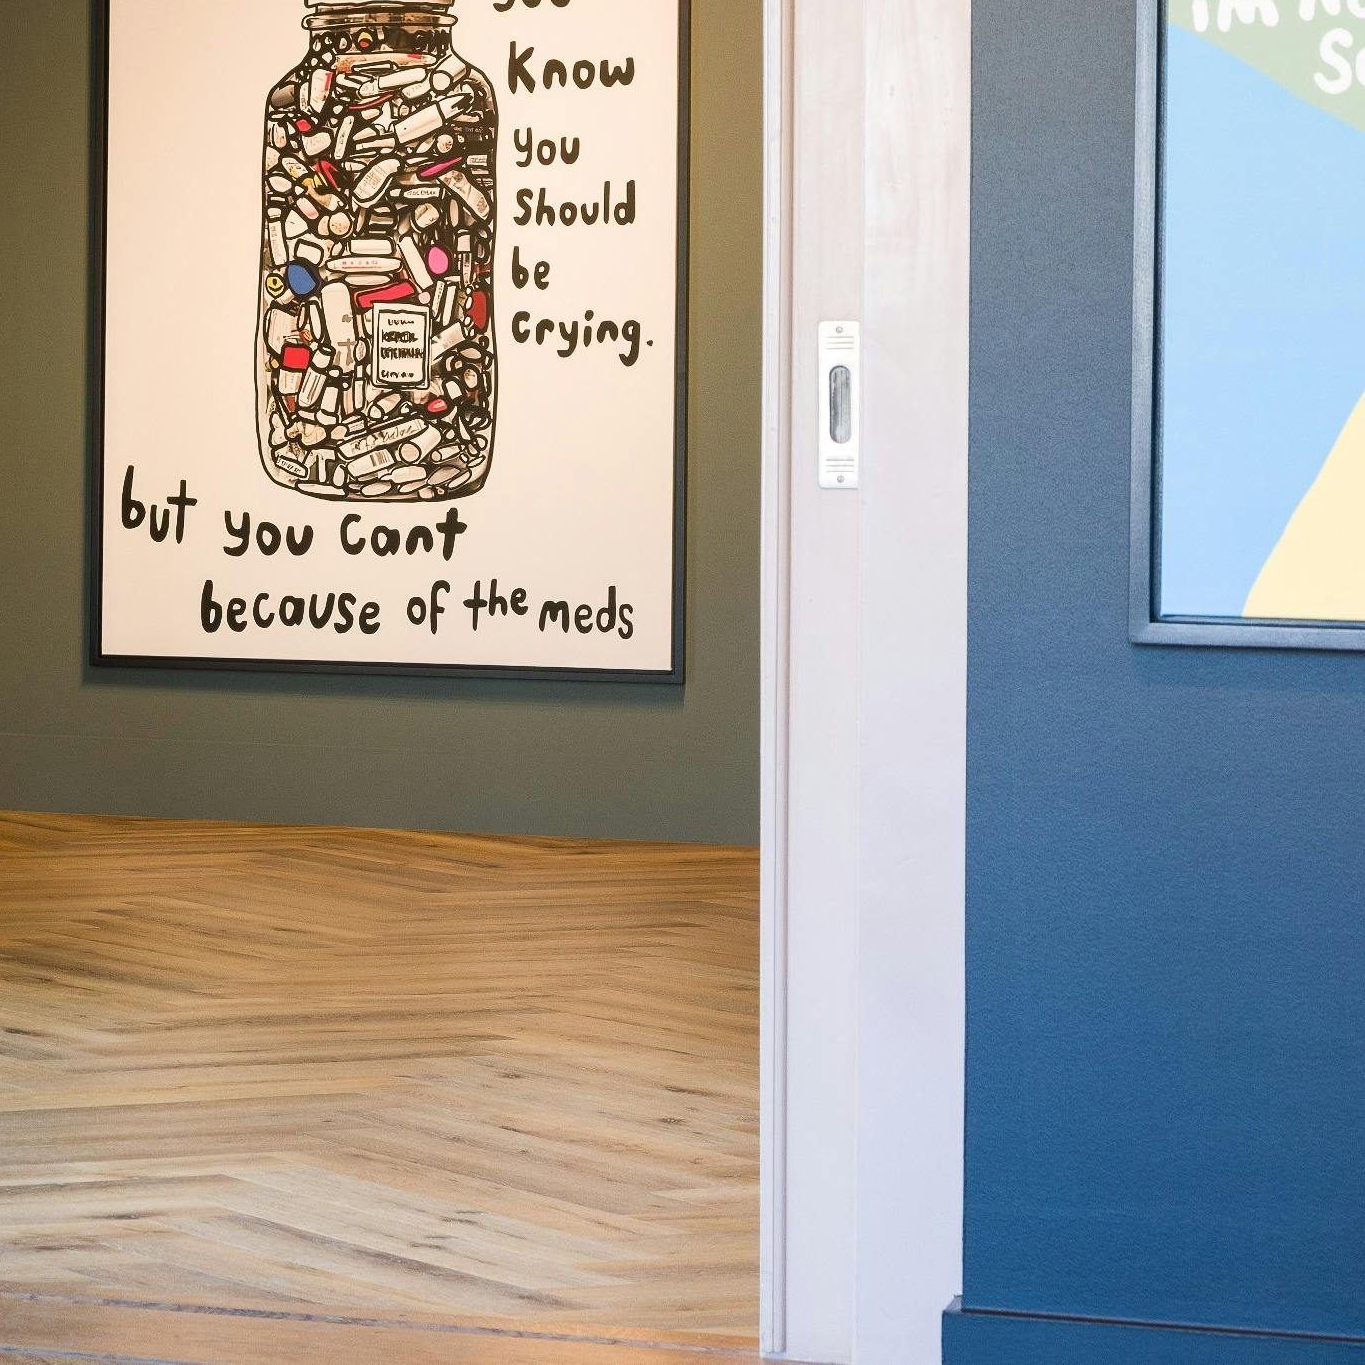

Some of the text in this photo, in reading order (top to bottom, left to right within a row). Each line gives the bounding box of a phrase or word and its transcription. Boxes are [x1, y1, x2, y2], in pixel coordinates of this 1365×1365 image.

[513, 126, 580, 168] you
[511, 245, 551, 291] be
[121, 464, 198, 545] but
[222, 510, 314, 557] you
[200, 578, 634, 640] because of the meds
